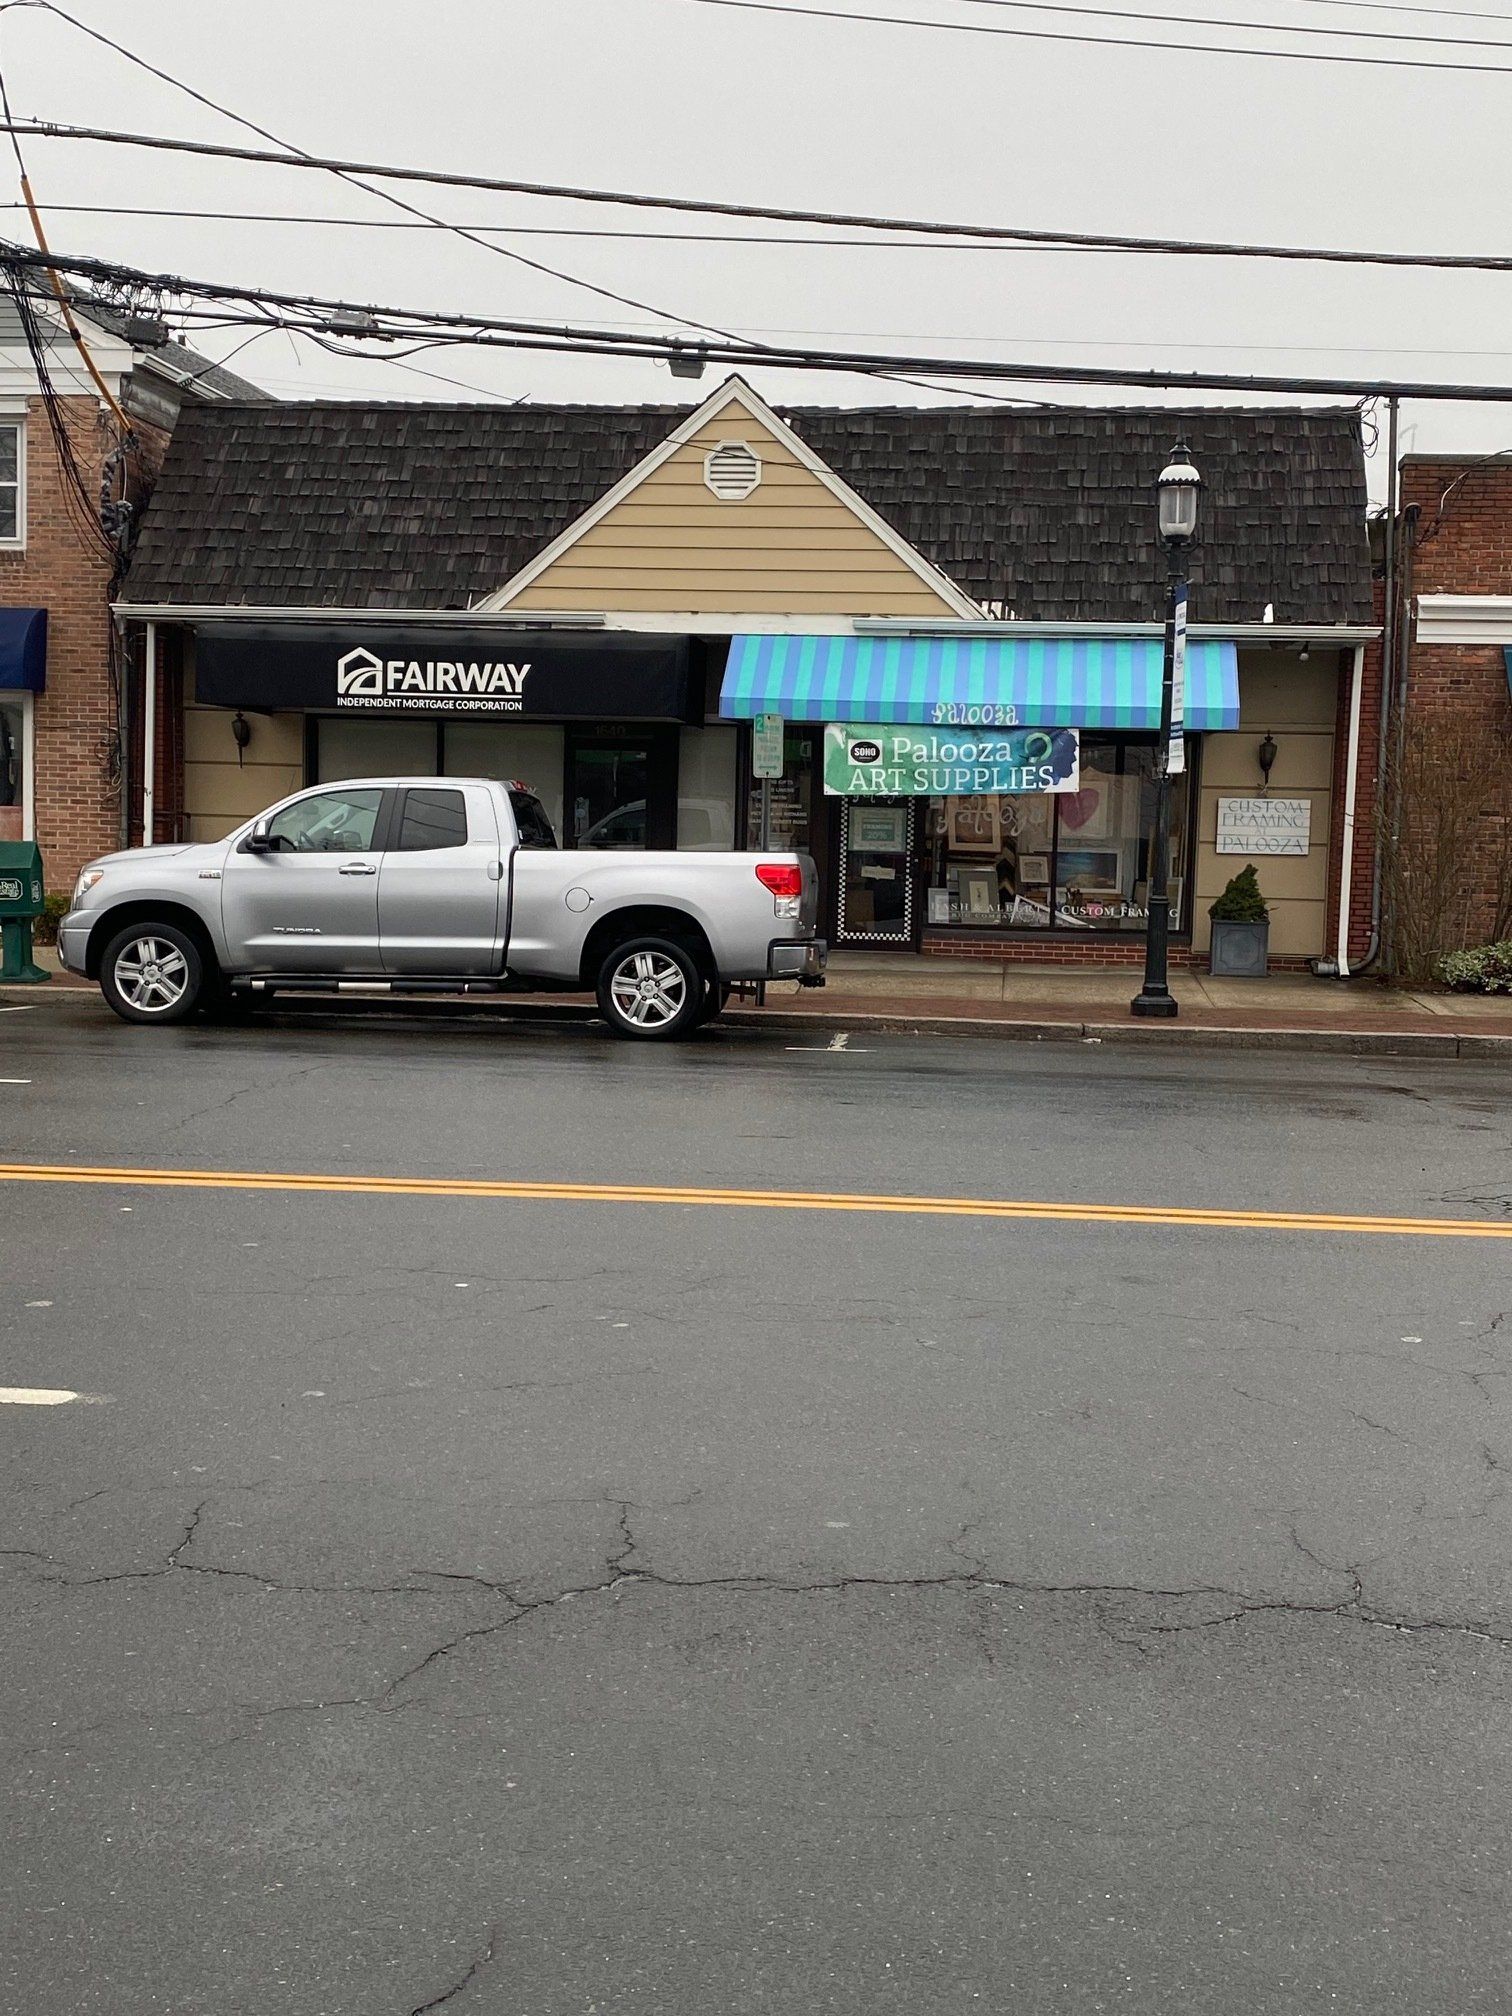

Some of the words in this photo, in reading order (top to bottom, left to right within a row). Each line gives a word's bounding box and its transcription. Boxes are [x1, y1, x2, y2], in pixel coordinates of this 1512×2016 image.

[386, 660, 532, 693] FAIRWAY
[337, 697, 401, 707] INDEPENDENT
[403, 699, 454, 709] MORTGAGE
[456, 700, 522, 710] CORPORATION
[756, 717, 763, 731] 2
[854, 747, 876, 757] SOHO
[892, 737, 1013, 763] Palooza
[848, 769, 906, 791] ART
[914, 766, 1055, 791] SUPPLIES
[1228, 800, 1303, 814] CUSTOM
[1222, 813, 1304, 828] FRAMING
[1222, 836, 1303, 853] PALOOZA
[1061, 905, 1115, 917] CUSTOM
[1120, 906, 1179, 918] FRAMG
